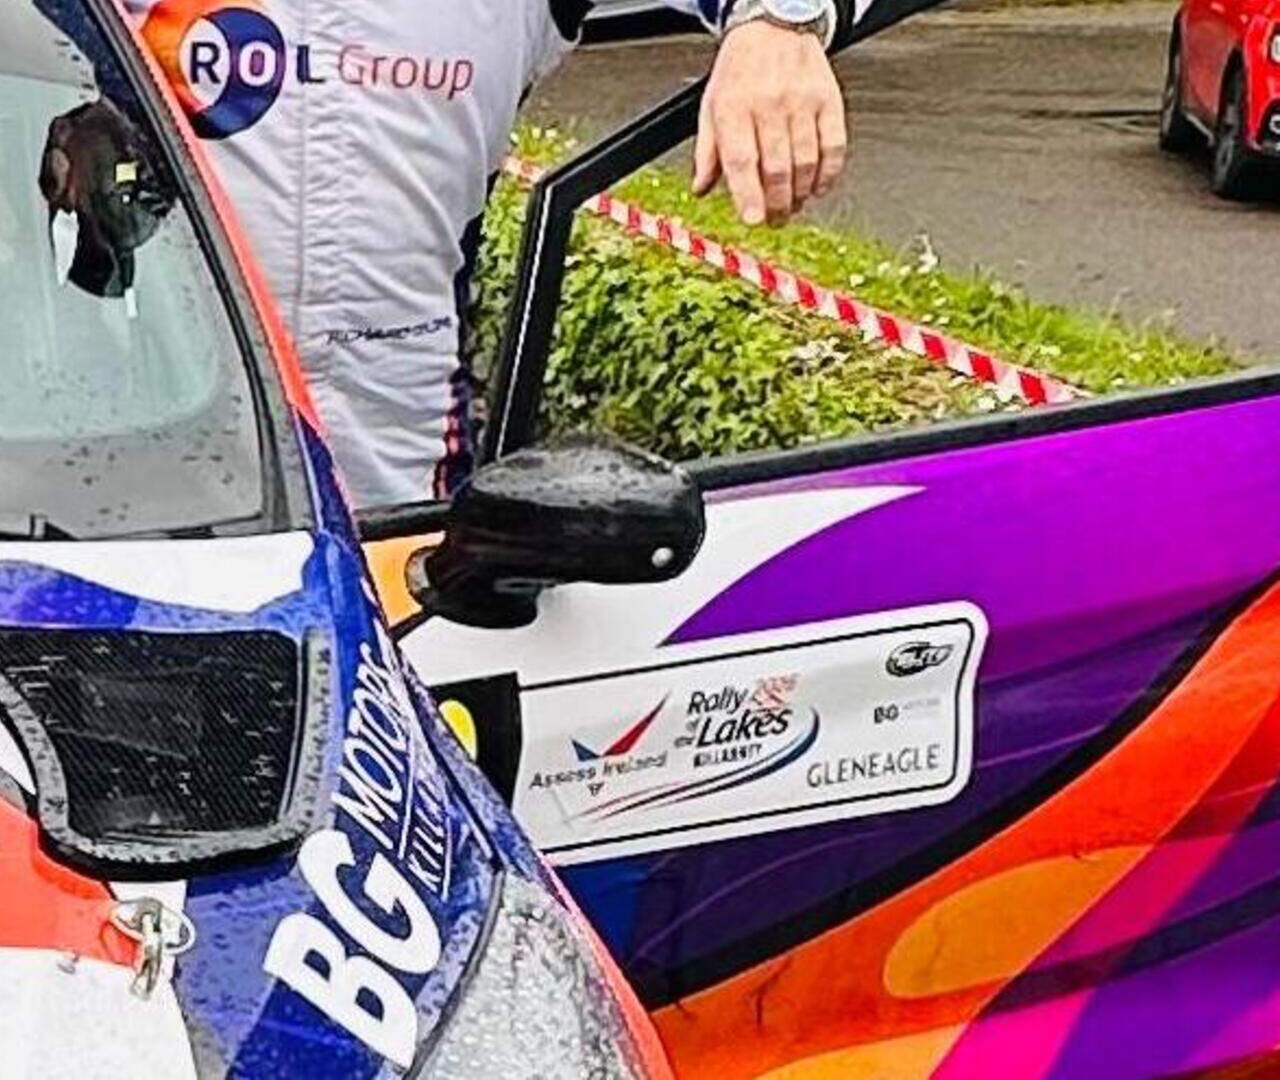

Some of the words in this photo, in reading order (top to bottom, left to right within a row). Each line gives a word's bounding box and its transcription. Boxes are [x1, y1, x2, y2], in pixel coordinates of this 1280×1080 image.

[189, 40, 325, 87] ROL
[338, 42, 474, 102] Group
[686, 686, 747, 716] Rally
[695, 708, 793, 748] Lakes
[806, 743, 941, 788] GLENEAGLE
[262, 829, 441, 1070] BG
